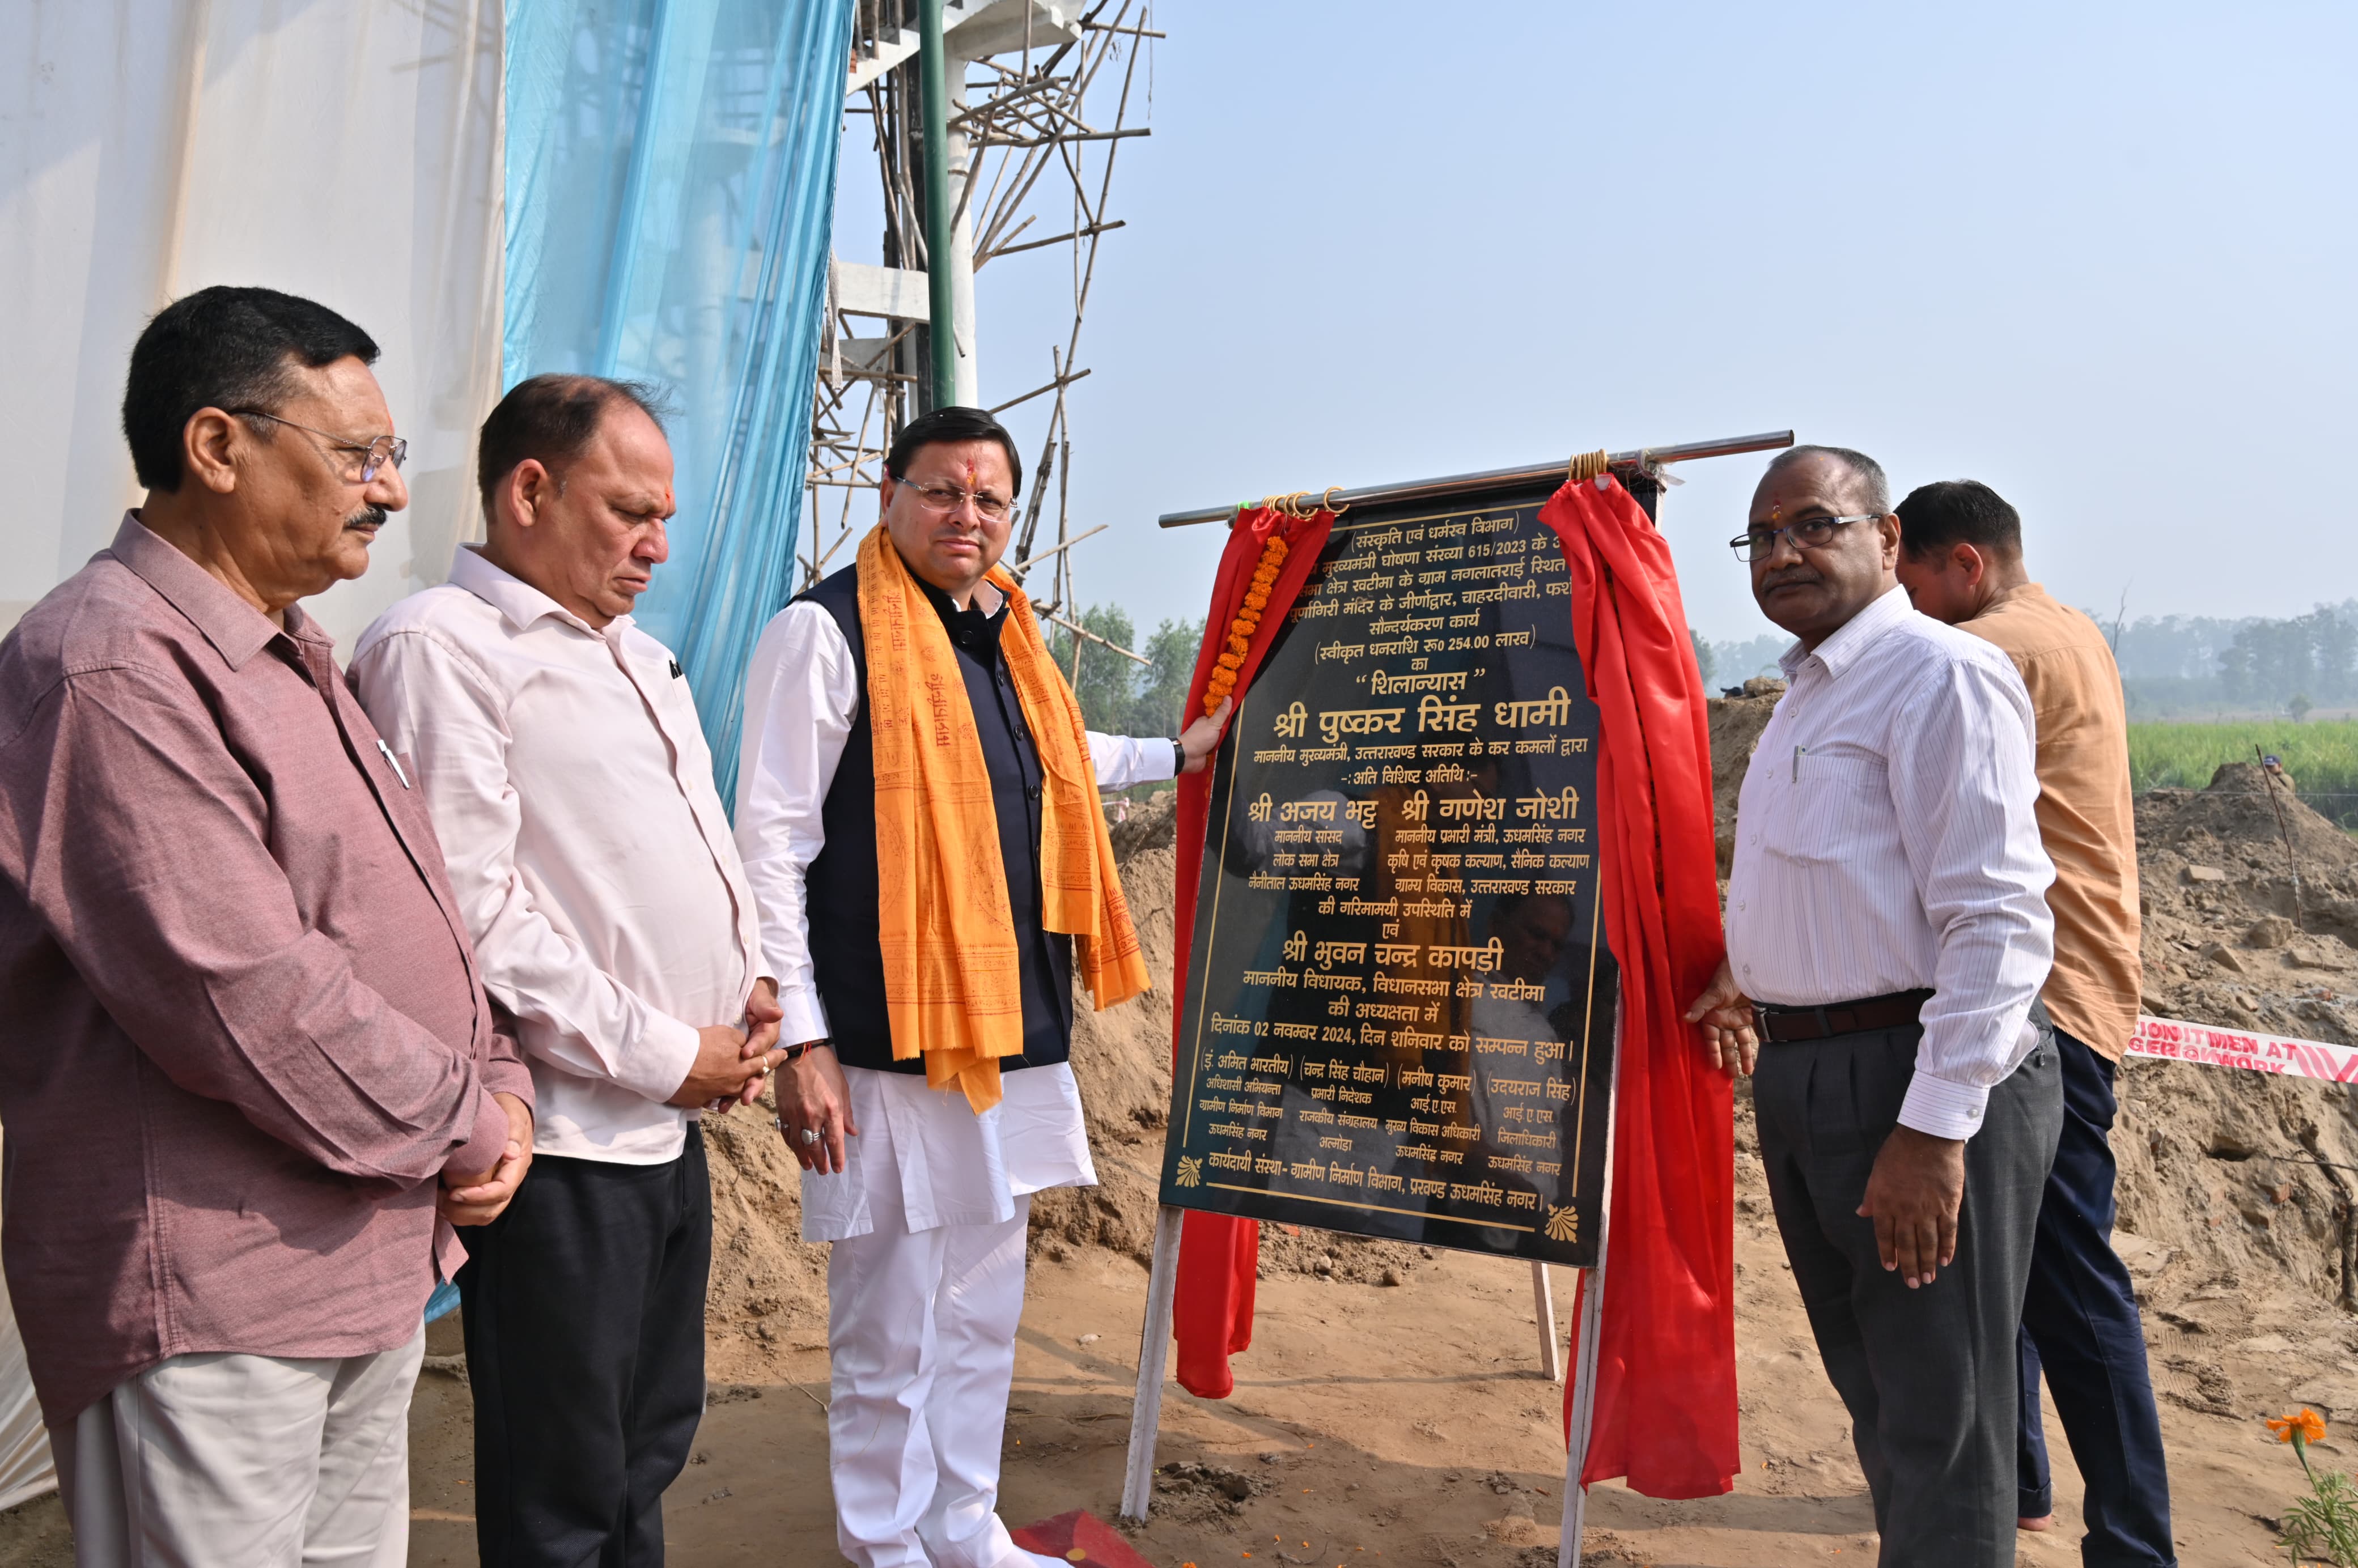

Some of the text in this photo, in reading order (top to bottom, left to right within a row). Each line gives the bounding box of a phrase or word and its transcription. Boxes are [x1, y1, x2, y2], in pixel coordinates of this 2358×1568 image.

[1351, 512, 1519, 553] (संस्कृति एवं धर्मस्व विभाग)
[1322, 551, 1377, 578] मुख्यमंत्री
[1381, 549, 1420, 567] घोषणा
[1426, 545, 1464, 562] संख्या
[1468, 539, 1526, 558] 615/2023
[1532, 533, 1547, 550] के
[1326, 577, 1348, 594] क्षेत्र
[1352, 572, 1394, 592] खटीमा
[1398, 569, 1414, 587] के
[1418, 571, 1447, 585] ग्राम
[1451, 556, 1525, 581] नगलातराई
[1530, 555, 1566, 573] स्थित
[1343, 595, 1375, 614] मंदिर
[1379, 593, 1395, 611] के
[1462, 579, 1541, 604] चाहरदीवारी,
[1369, 607, 1481, 635] सौन्दर्यकरण कार्य
[1315, 640, 1365, 665] (स्वीकृत
[1369, 635, 1419, 656] धनराशि
[1448, 635, 1490, 651] 254.00
[1495, 625, 1536, 647] लाख)
[1411, 657, 1429, 671] का
[1273, 686, 1571, 743] श्री पुष्कर सिंह धामी
[1254, 734, 1588, 767] माननीय मुख्यमंत्री, उत्तराखण्ड सरकार के कर कमलों द्वारा
[1382, 764, 1422, 784] विशिष्ट
[1248, 792, 1379, 829] श्री अजय भट्ट
[1401, 786, 1579, 821] श्री गणेश जोशी
[1274, 825, 1343, 844] माननीय सांसद
[1395, 823, 1436, 843] माननीय
[1440, 823, 1470, 843] प्रभारी
[1474, 823, 1499, 844] मंत्री,
[1558, 828, 1586, 843] नगर
[1273, 848, 1339, 867] लोक सभा क्षेत्र
[1388, 848, 1590, 874] कृषि एवं कृषक कल्याण, सैनिक कल्याण
[1248, 870, 1286, 890] नैनीताल
[1335, 878, 1360, 891] नगर
[1395, 873, 1576, 895] ग्राम्य विकास, उत्तराखण्ड सरकार
[1318, 895, 1473, 919] की गरिमामयी उपस्थिति में
[1382, 919, 1399, 939] एवं
[1282, 930, 1504, 975] श्री भुवन चन्द्र कापड़ी
[1243, 966, 1545, 1001] माननीय विधायक, विधानसभा क्षेत्र खटीमा
[1328, 995, 1440, 1023] की अध्यक्षता में
[1211, 1012, 1251, 1034] दिनांक
[1254, 1021, 1269, 1036] 02
[1273, 1023, 1318, 1040] नवम्बर
[1321, 1026, 1356, 1046] 2024,
[1360, 1022, 1386, 1046] दिन
[1390, 1026, 1444, 1050] शनिवार
[1449, 1029, 1470, 1052] को
[1475, 1037, 1528, 1056] सम्पन्न
[2207, 1031, 2258, 1055] MEN
[2266, 1042, 2297, 1061] AT
[1218, 1050, 1248, 1070] अमित
[1250, 1053, 1293, 1079] भारतीय)
[1300, 1055, 1389, 1088] (चन्द्र सिंह चौहान)
[1206, 1074, 1282, 1095] अधिशासी अभियन्ता
[1398, 1063, 1476, 1097] (मनीष कुमार)
[1487, 1071, 1576, 1105] (उदयराज सिंह)
[1199, 1096, 1283, 1119] ग्रामीण निर्माण विभाग
[1311, 1084, 1372, 1104] प्रभारी निदेशक
[1299, 1107, 1378, 1129] राजकीय संग्रहालय
[1385, 1117, 1481, 1141] मुख्य विकास अधिकारी
[1247, 1128, 1267, 1141] नगर
[1320, 1133, 1352, 1152] अल्मोड़ा
[1498, 1127, 1556, 1148] जिलाधिकारी
[1440, 1150, 1464, 1165] नगर
[1537, 1162, 1562, 1176] नगर
[1208, 1147, 1252, 1172] कार्यदायी
[1291, 1158, 1326, 1182] ग्रामीण
[1329, 1161, 1364, 1187] निर्माण
[1368, 1166, 1405, 1195] विभाग,
[1410, 1178, 1447, 1199] प्रखण्ड
